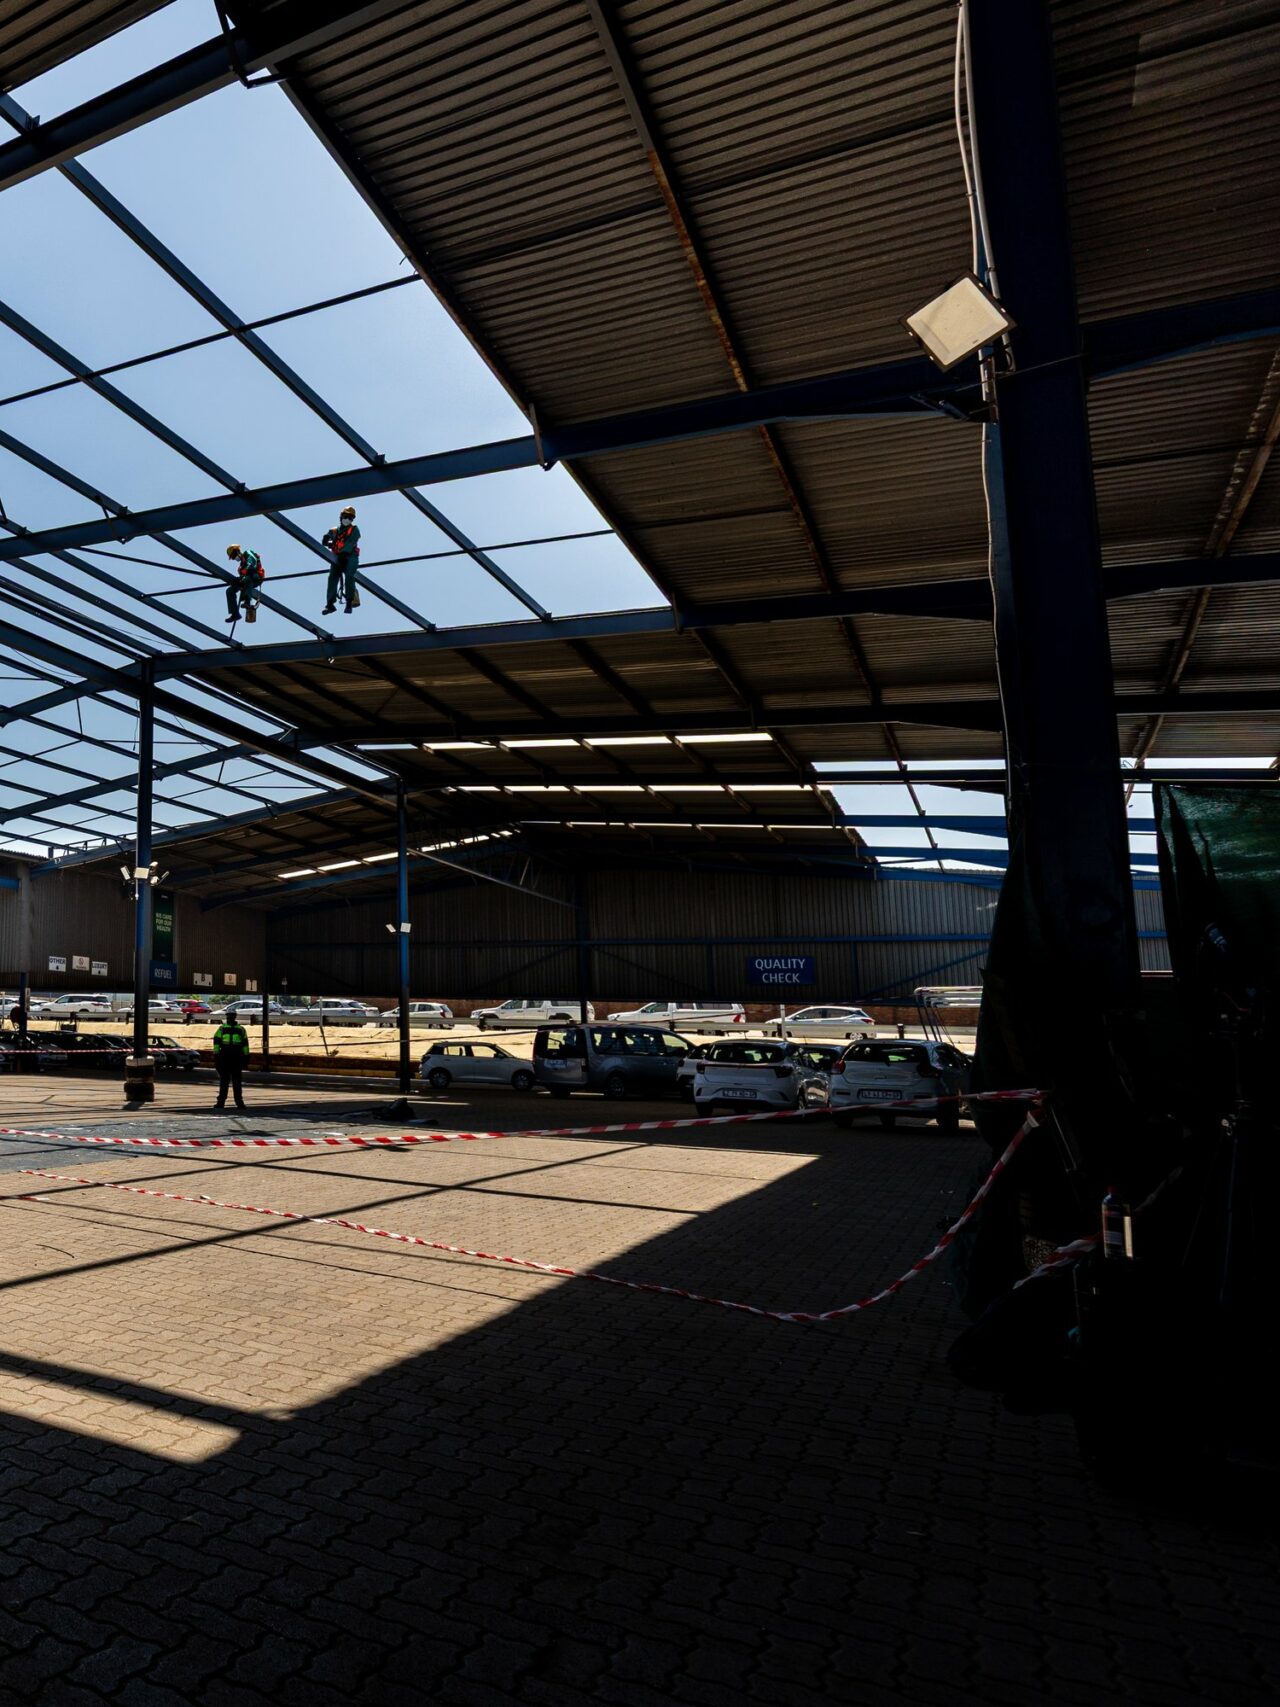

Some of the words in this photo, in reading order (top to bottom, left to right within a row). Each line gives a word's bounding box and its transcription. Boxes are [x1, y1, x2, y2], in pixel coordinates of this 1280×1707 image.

[49, 957, 65, 965] OTHER
[755, 958, 805, 971] QUALITY
[154, 968, 172, 979] REFUEL
[762, 972, 800, 983] CHECK
